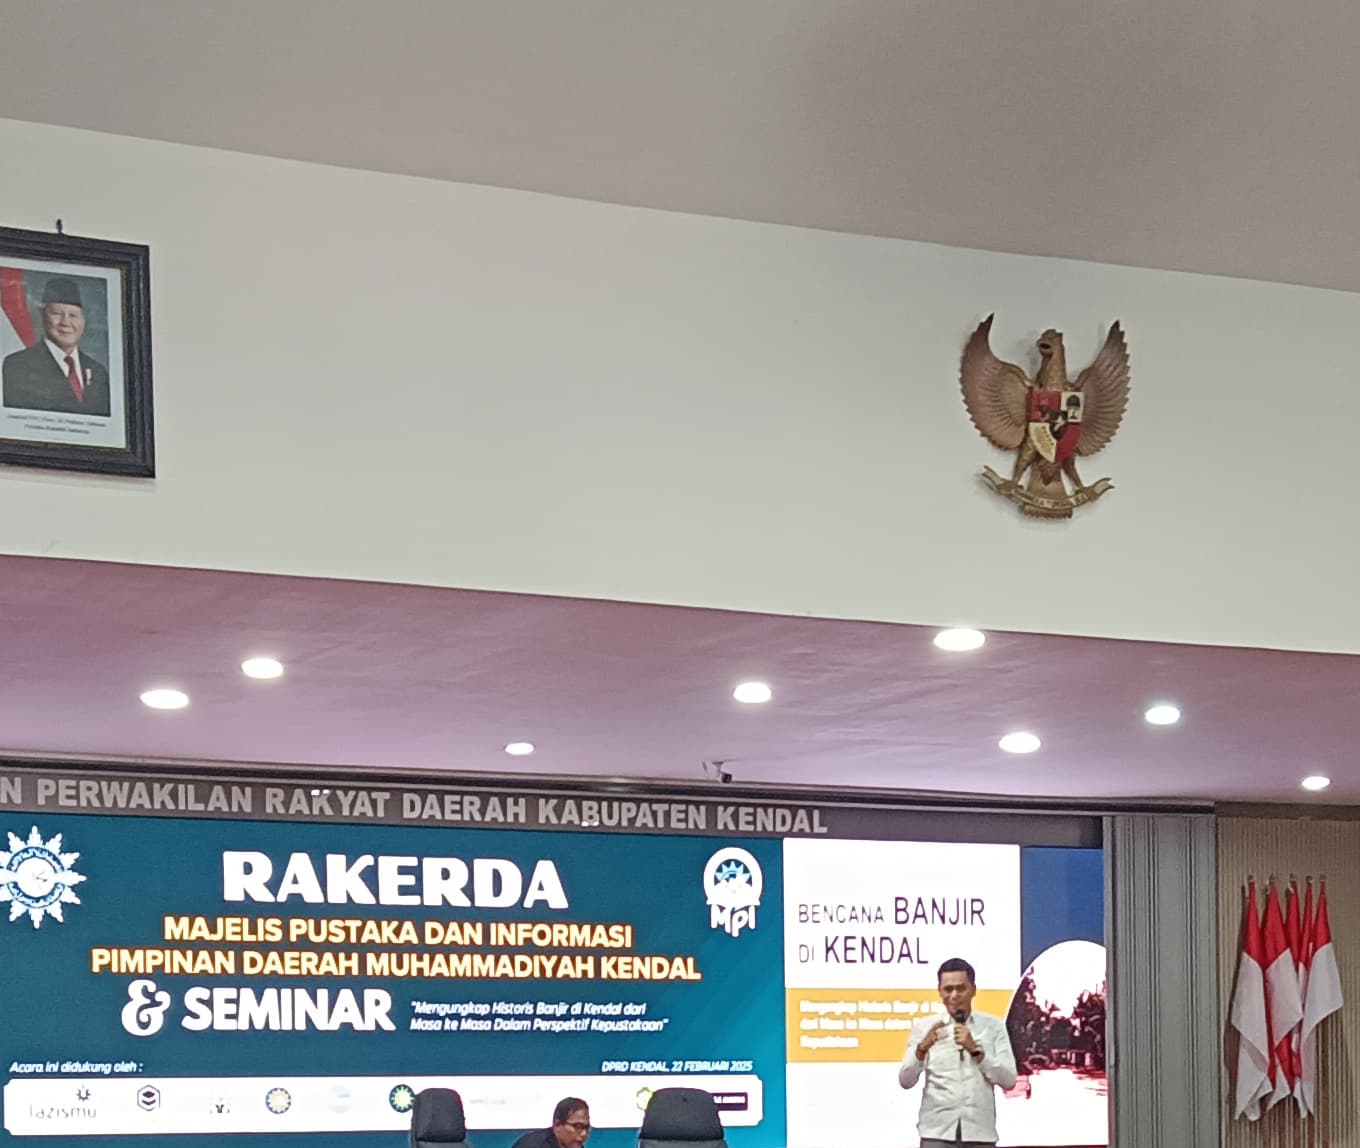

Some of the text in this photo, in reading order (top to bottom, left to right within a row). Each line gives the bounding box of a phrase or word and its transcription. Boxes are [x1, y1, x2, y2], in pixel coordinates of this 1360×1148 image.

[37, 778, 252, 814] PERWAKILAN
[265, 788, 390, 819] RAKYAT
[402, 793, 526, 825] DAERAH
[539, 799, 707, 831] KABUPATEN
[716, 806, 828, 834] KENDAL
[222, 850, 569, 909] RAKERDA
[798, 896, 986, 926] BENCANA BANJIR
[164, 916, 633, 949] MAJELIS PUSTAKA DAN INFORMASI
[91, 948, 702, 980] PIMPINAN DAERAH MUHAMMADIYAH KENDAL
[798, 935, 929, 964] DI KENDAL
[121, 979, 397, 1037] & SEMINAR
[492, 1001, 535, 1015] Historis
[536, 1002, 568, 1018] Banjir
[570, 1002, 583, 1015] di
[584, 1002, 622, 1016] Kendal
[624, 1002, 648, 1016] dari
[409, 1018, 442, 1032] Masa
[444, 1018, 459, 1031] ke
[460, 1018, 493, 1032] Masa
[494, 1018, 532, 1032] Dalam
[533, 1018, 590, 1034] Perspektif
[9, 1061, 43, 1073] Acara
[45, 1061, 59, 1073] ini
[60, 1061, 112, 1075] didukung
[113, 1061, 137, 1073] oleh
[601, 1060, 628, 1073] DPRD
[683, 1061, 729, 1073] FEBRUARI
[29, 1103, 97, 1119] lazismu
